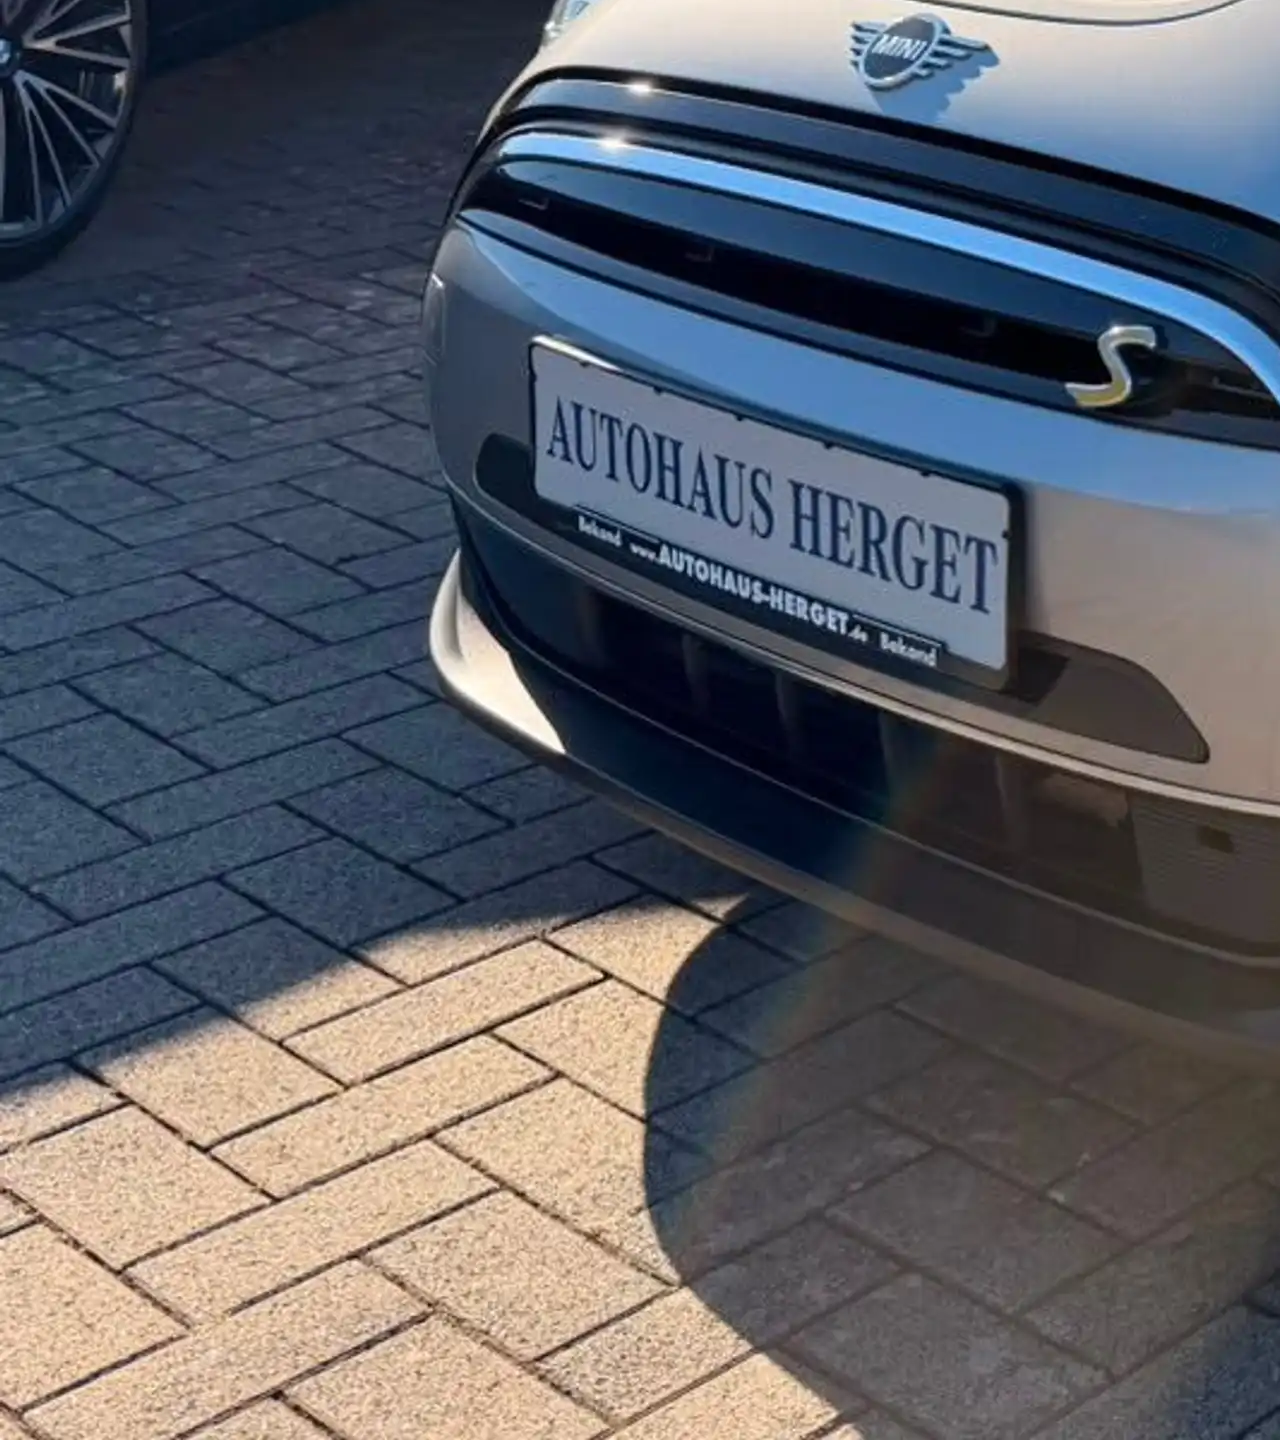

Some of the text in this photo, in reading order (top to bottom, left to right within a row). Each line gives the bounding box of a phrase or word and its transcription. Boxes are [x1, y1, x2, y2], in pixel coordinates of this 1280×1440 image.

[871, 33, 928, 60] MINI
[1064, 325, 1156, 407] S
[545, 395, 999, 615] AUTOHAUS HERGET
